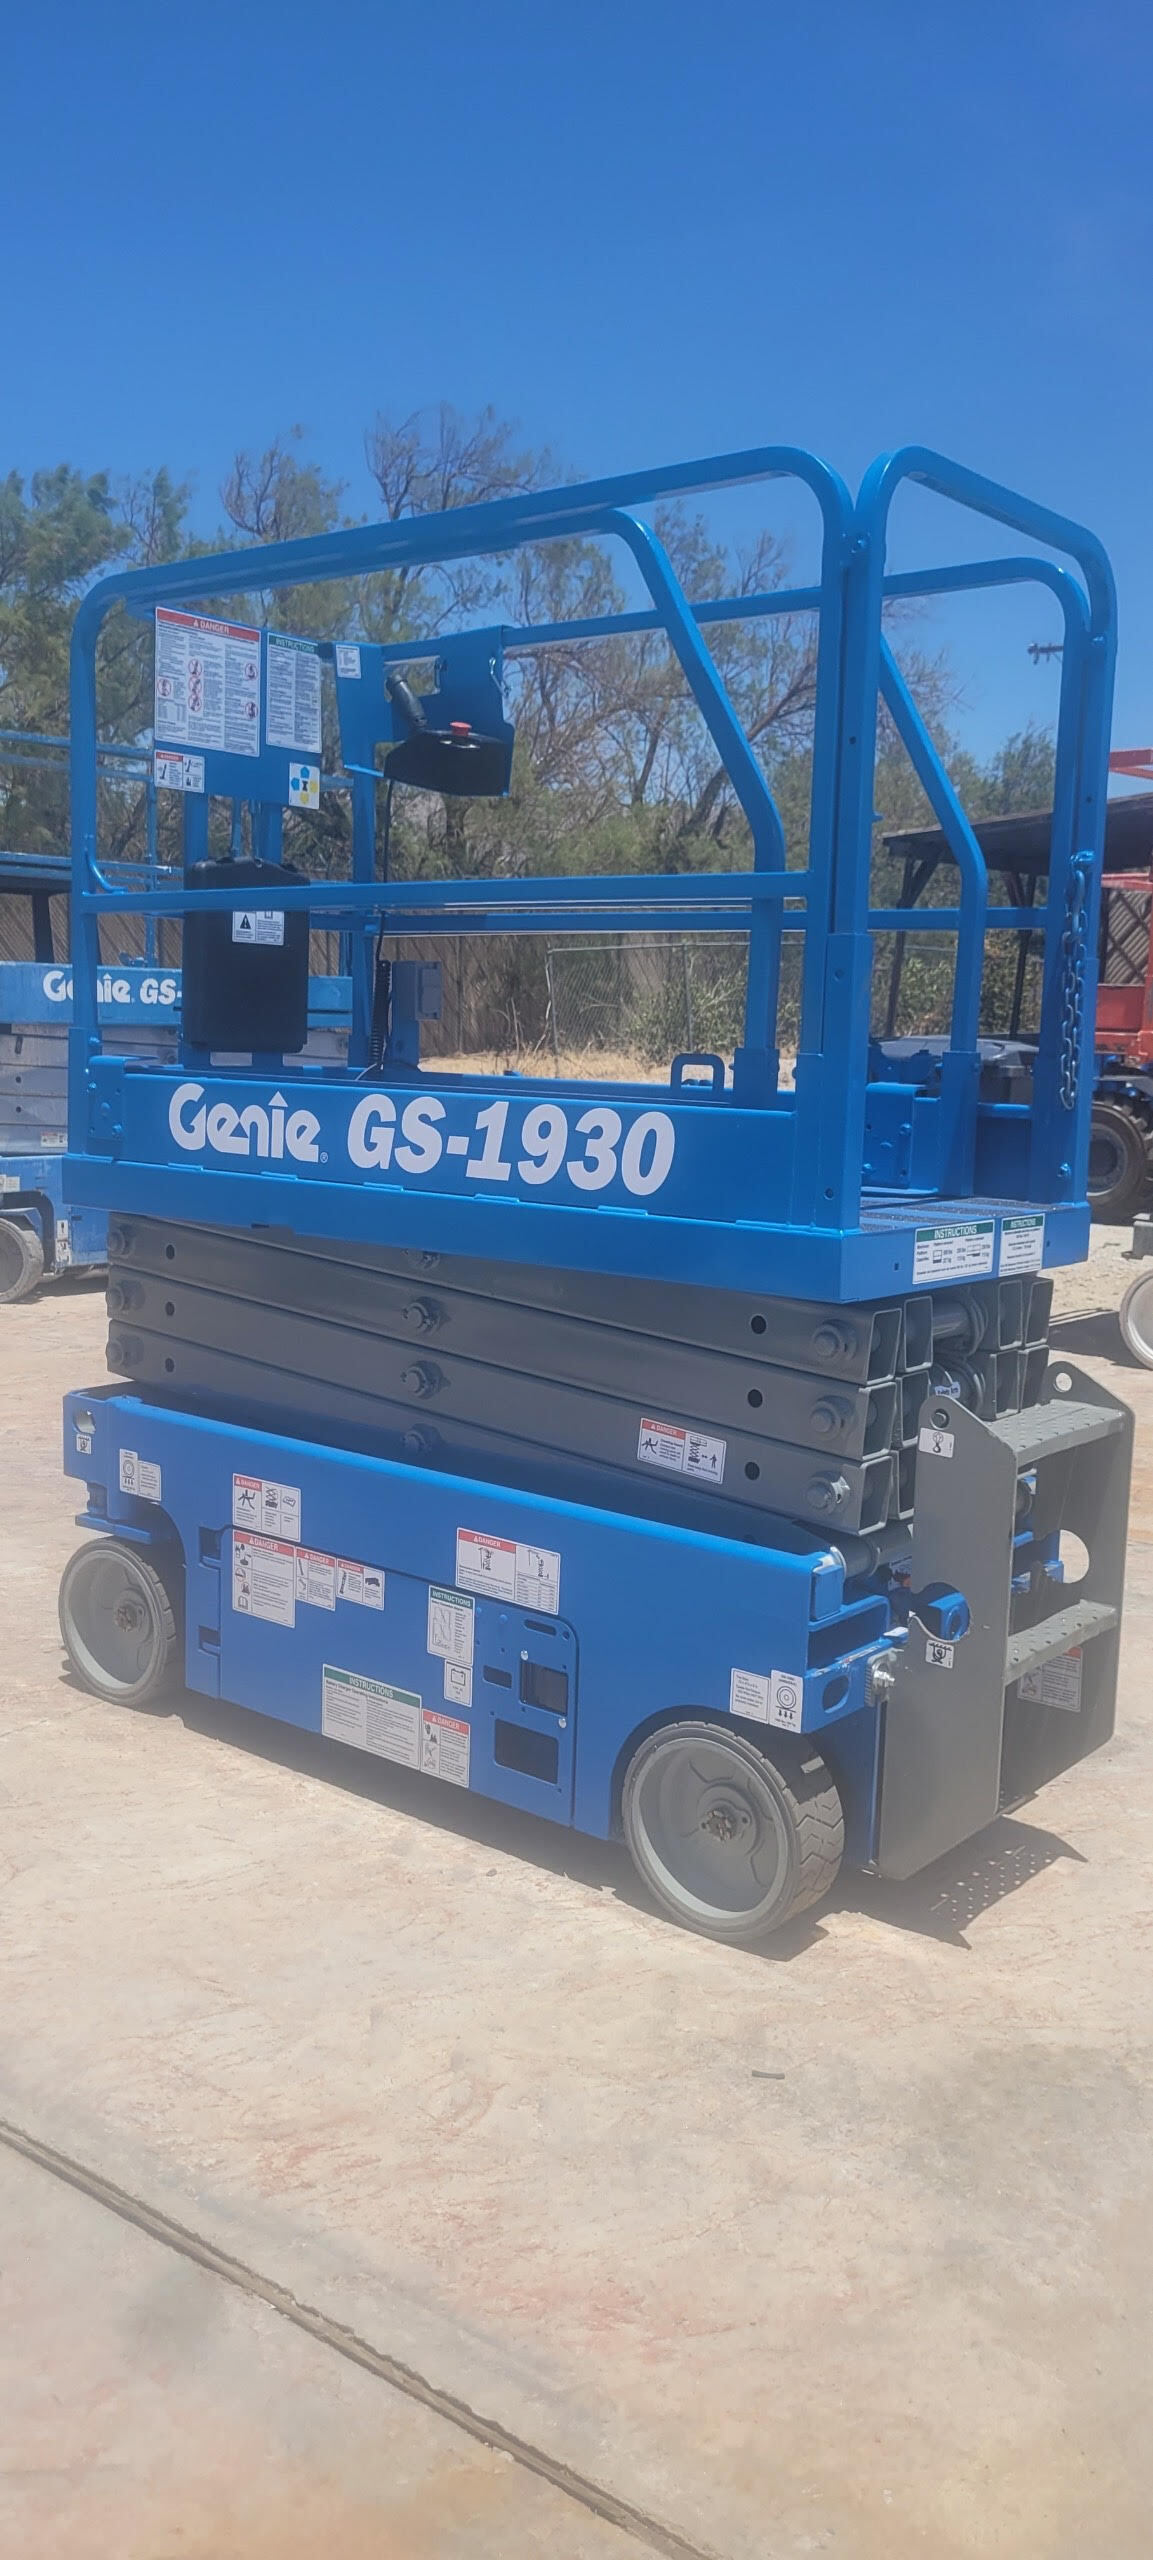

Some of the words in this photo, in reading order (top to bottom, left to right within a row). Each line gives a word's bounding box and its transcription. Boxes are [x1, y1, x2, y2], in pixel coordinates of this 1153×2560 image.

[200, 622, 229, 634] DANGER
[275, 638, 315, 653] INSTRUCTIONS
[169, 1083, 320, 1163] Genie
[347, 1093, 675, 1196] GS-1930
[934, 1225, 977, 1239] INSTRUCTIONS
[656, 1424, 678, 1435] DANGER
[240, 1478, 260, 1488] DANGER
[254, 1538, 279, 1551] DANGER
[478, 1536, 501, 1547] DANGER
[309, 1553, 329, 1565] DANGER
[432, 1590, 471, 1608] INSTRUCTIONS
[349, 1677, 394, 1698] INSTRUCTIONS
[437, 1717, 460, 1730] DANGER
